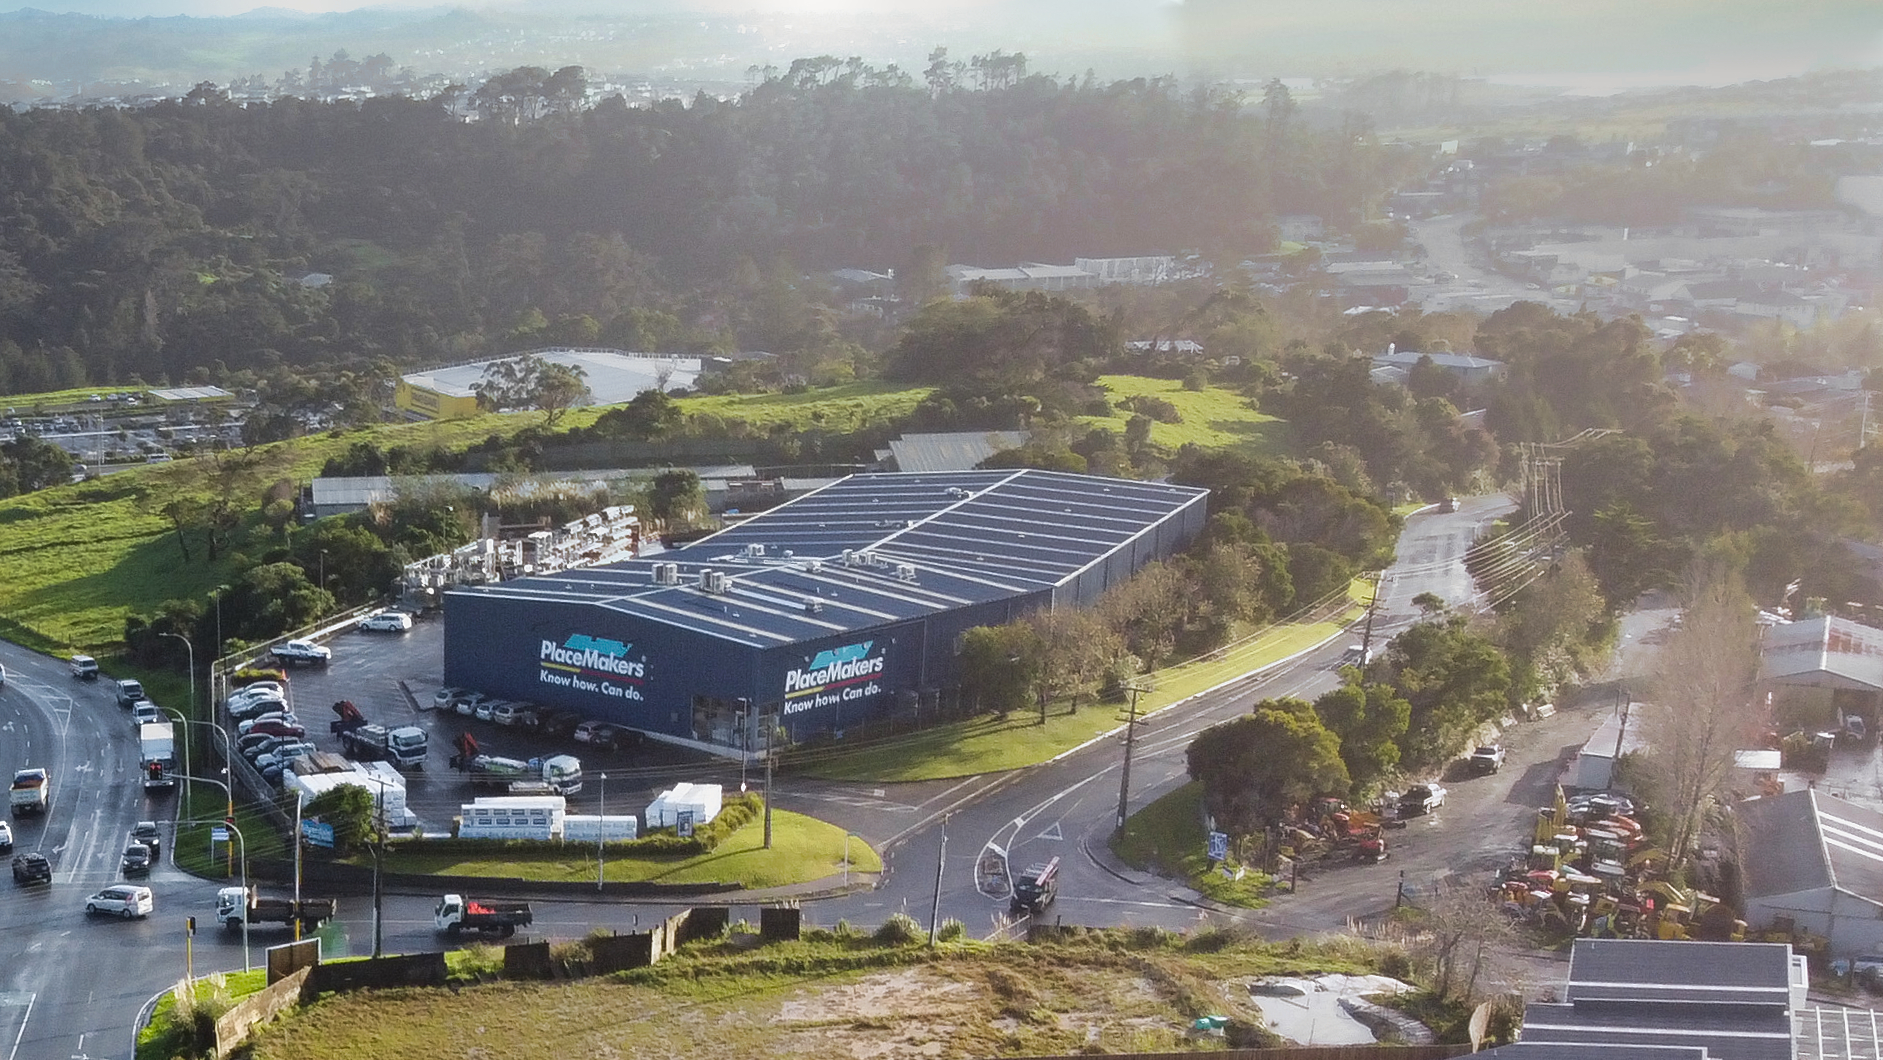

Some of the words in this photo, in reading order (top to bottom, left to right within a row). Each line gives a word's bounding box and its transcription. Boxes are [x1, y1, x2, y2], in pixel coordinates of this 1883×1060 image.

[540, 640, 644, 678] PlaceMakers
[785, 656, 884, 692] PlaceMakers
[540, 669, 571, 686] Know
[572, 675, 599, 692] how.
[601, 682, 623, 697] Can
[625, 686, 644, 701] do.
[784, 700, 814, 715] Know
[842, 687, 863, 700] Can
[864, 681, 881, 696] do.
